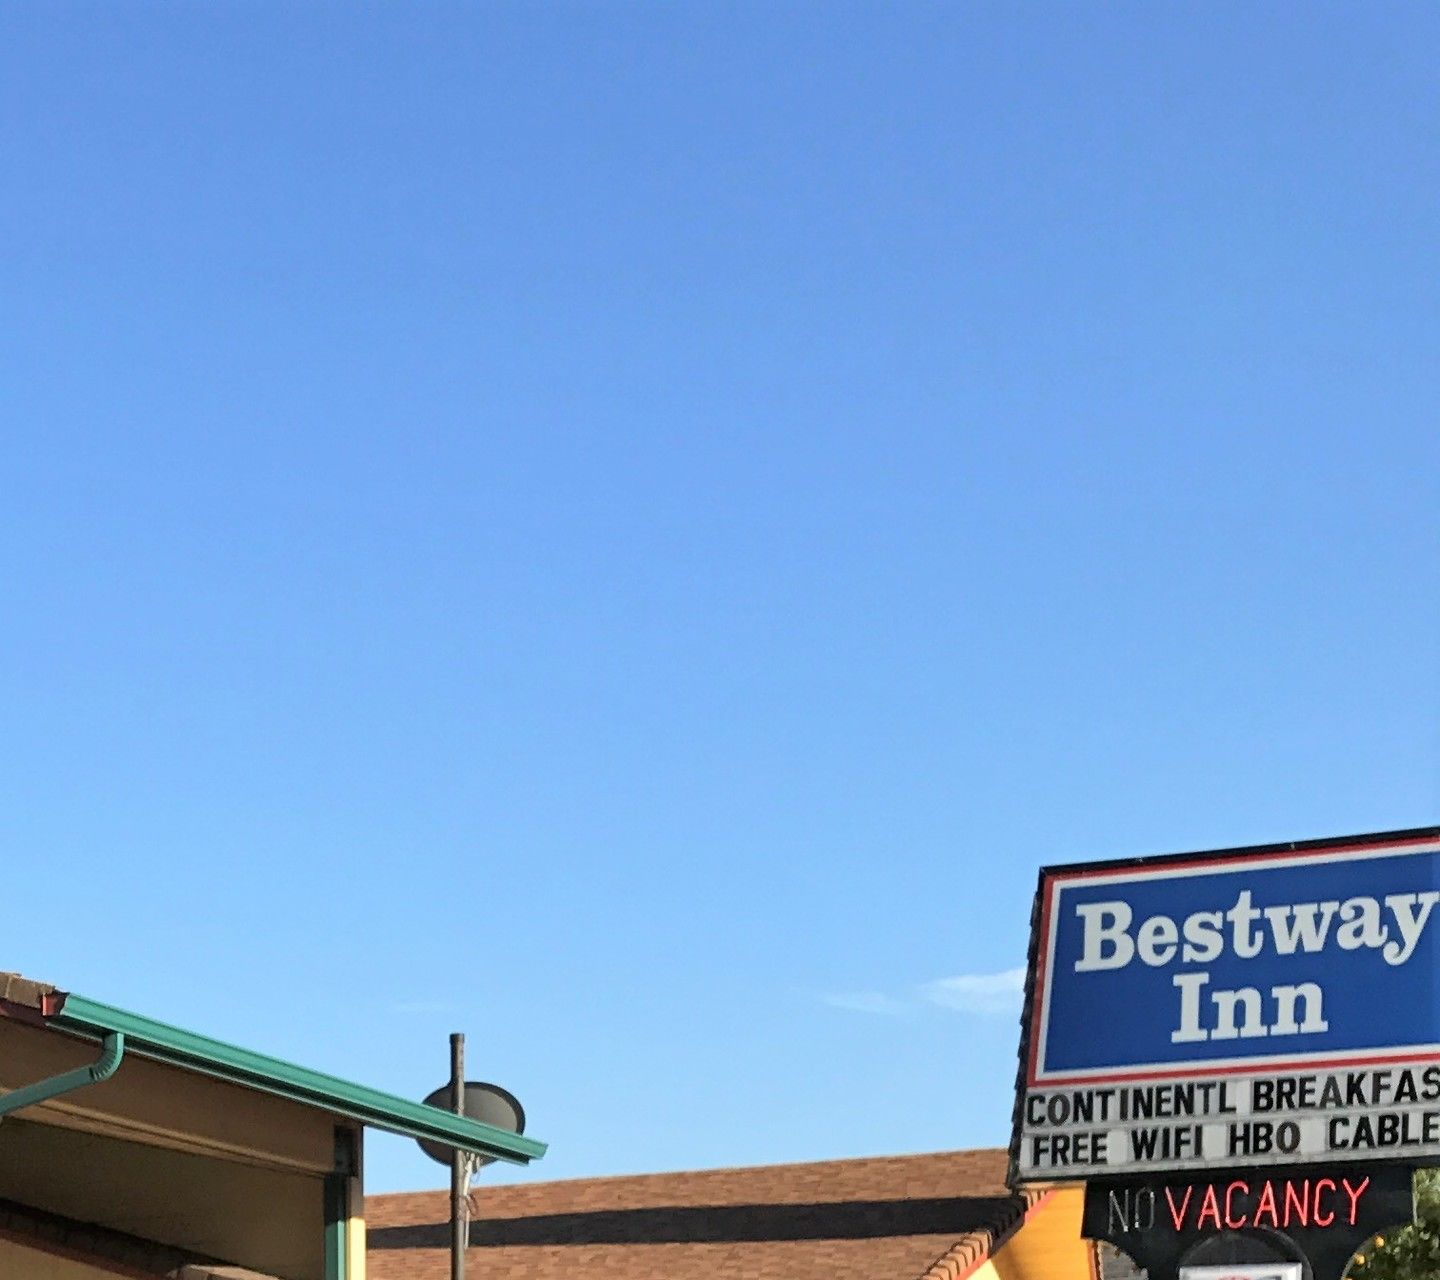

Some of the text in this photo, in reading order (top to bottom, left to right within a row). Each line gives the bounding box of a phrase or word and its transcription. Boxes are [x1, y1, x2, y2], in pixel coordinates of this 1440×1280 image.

[1074, 889, 1440, 973] Bestway
[1171, 971, 1329, 1044] Inn
[1026, 1065, 1440, 1127] CONTINENTL BREAKFAS
[1033, 1111, 1440, 1167] FREE WIFI HBO CABLE
[1108, 1176, 1370, 1234] NO VACANCY
